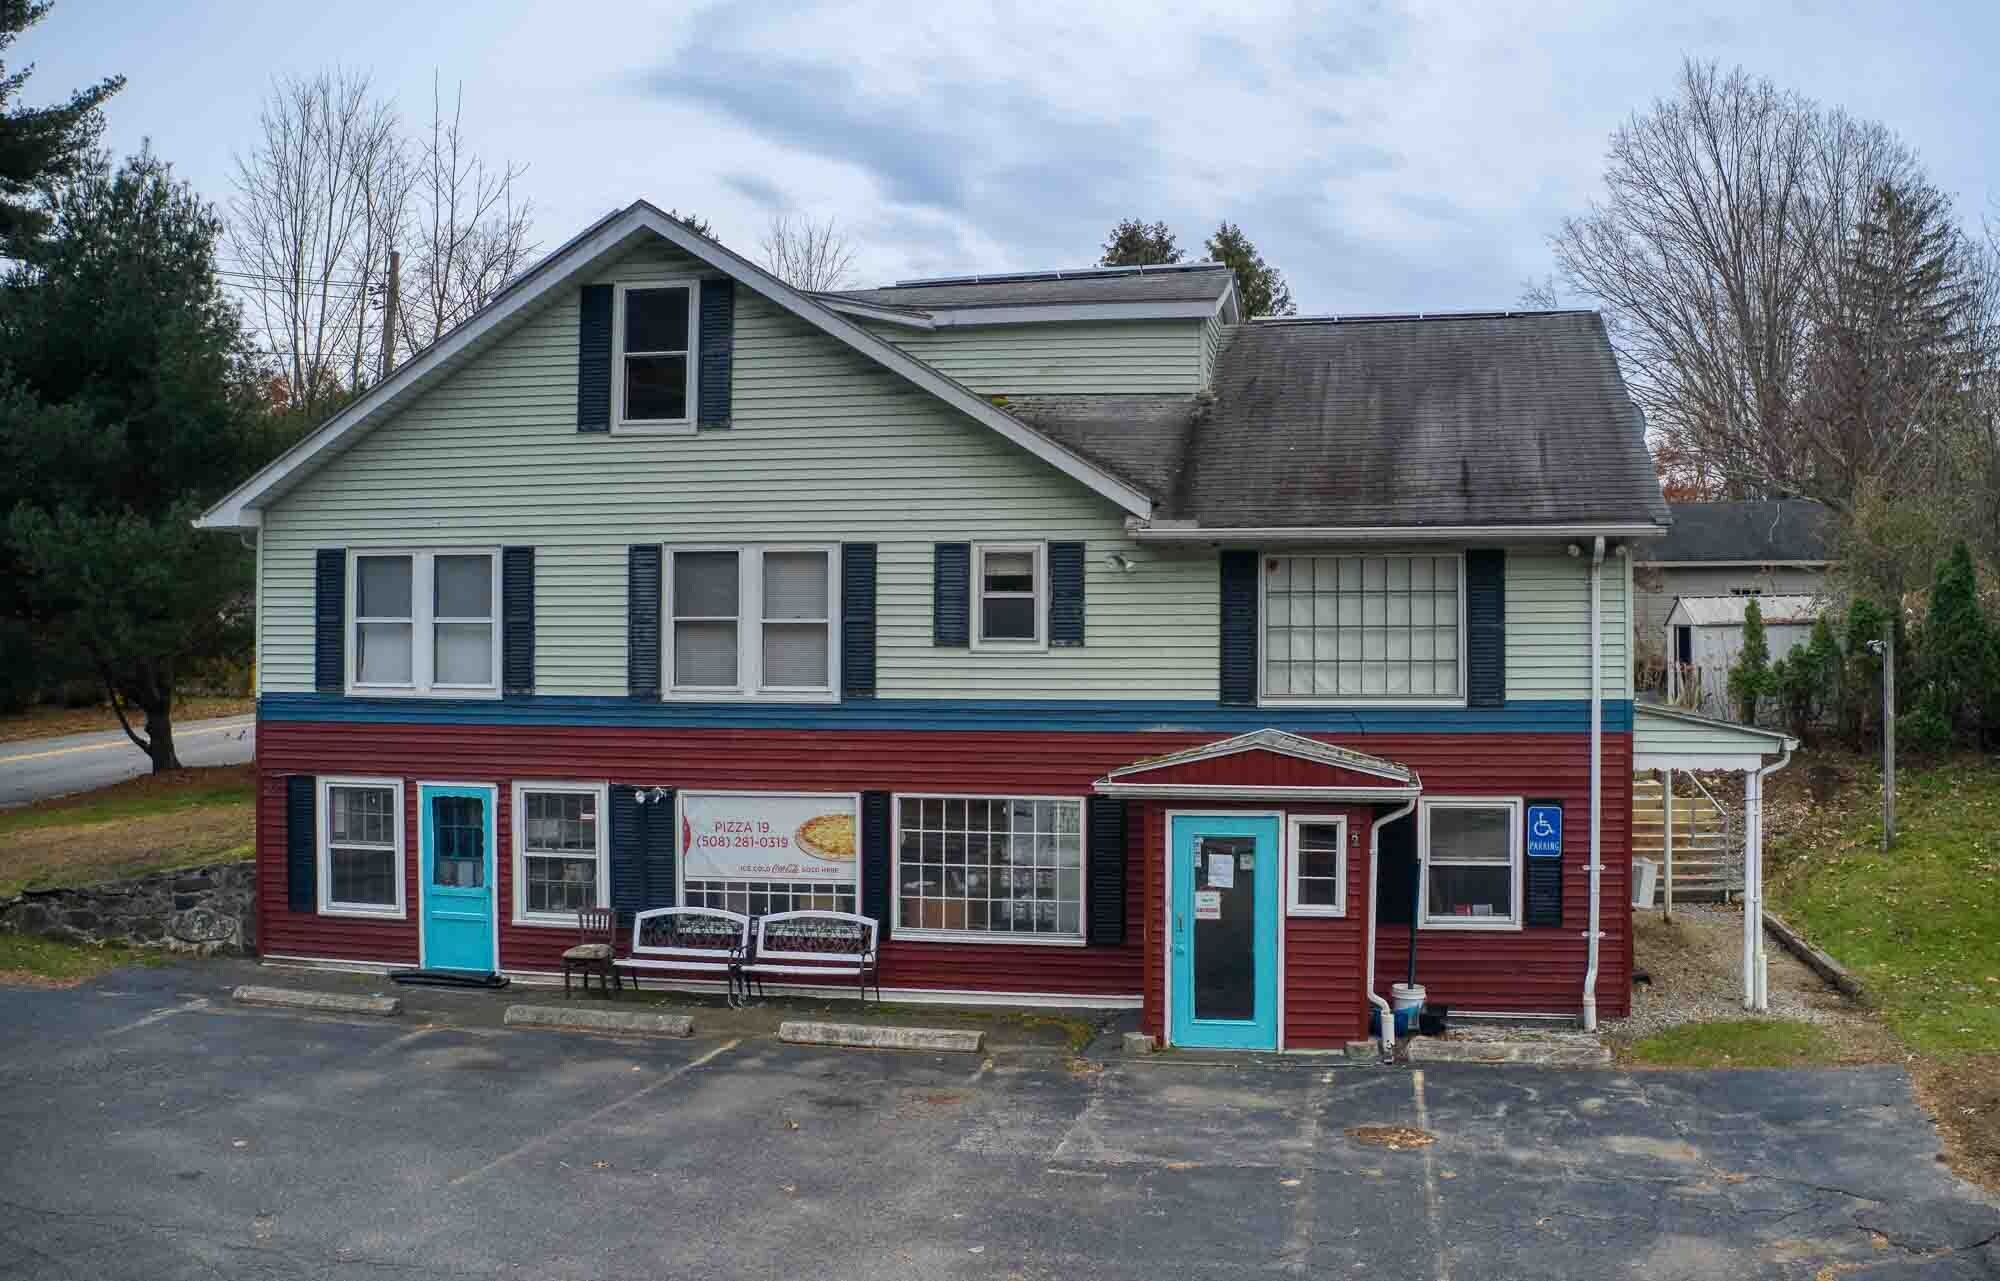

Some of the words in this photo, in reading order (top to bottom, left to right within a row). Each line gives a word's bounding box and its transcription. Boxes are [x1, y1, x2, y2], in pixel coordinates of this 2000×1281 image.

[715, 821, 753, 833] PIZZA
[757, 822, 770, 833] 19
[696, 835, 730, 849] (508)
[734, 836, 789, 849] 281-0319
[1529, 840, 1560, 851] PARKING
